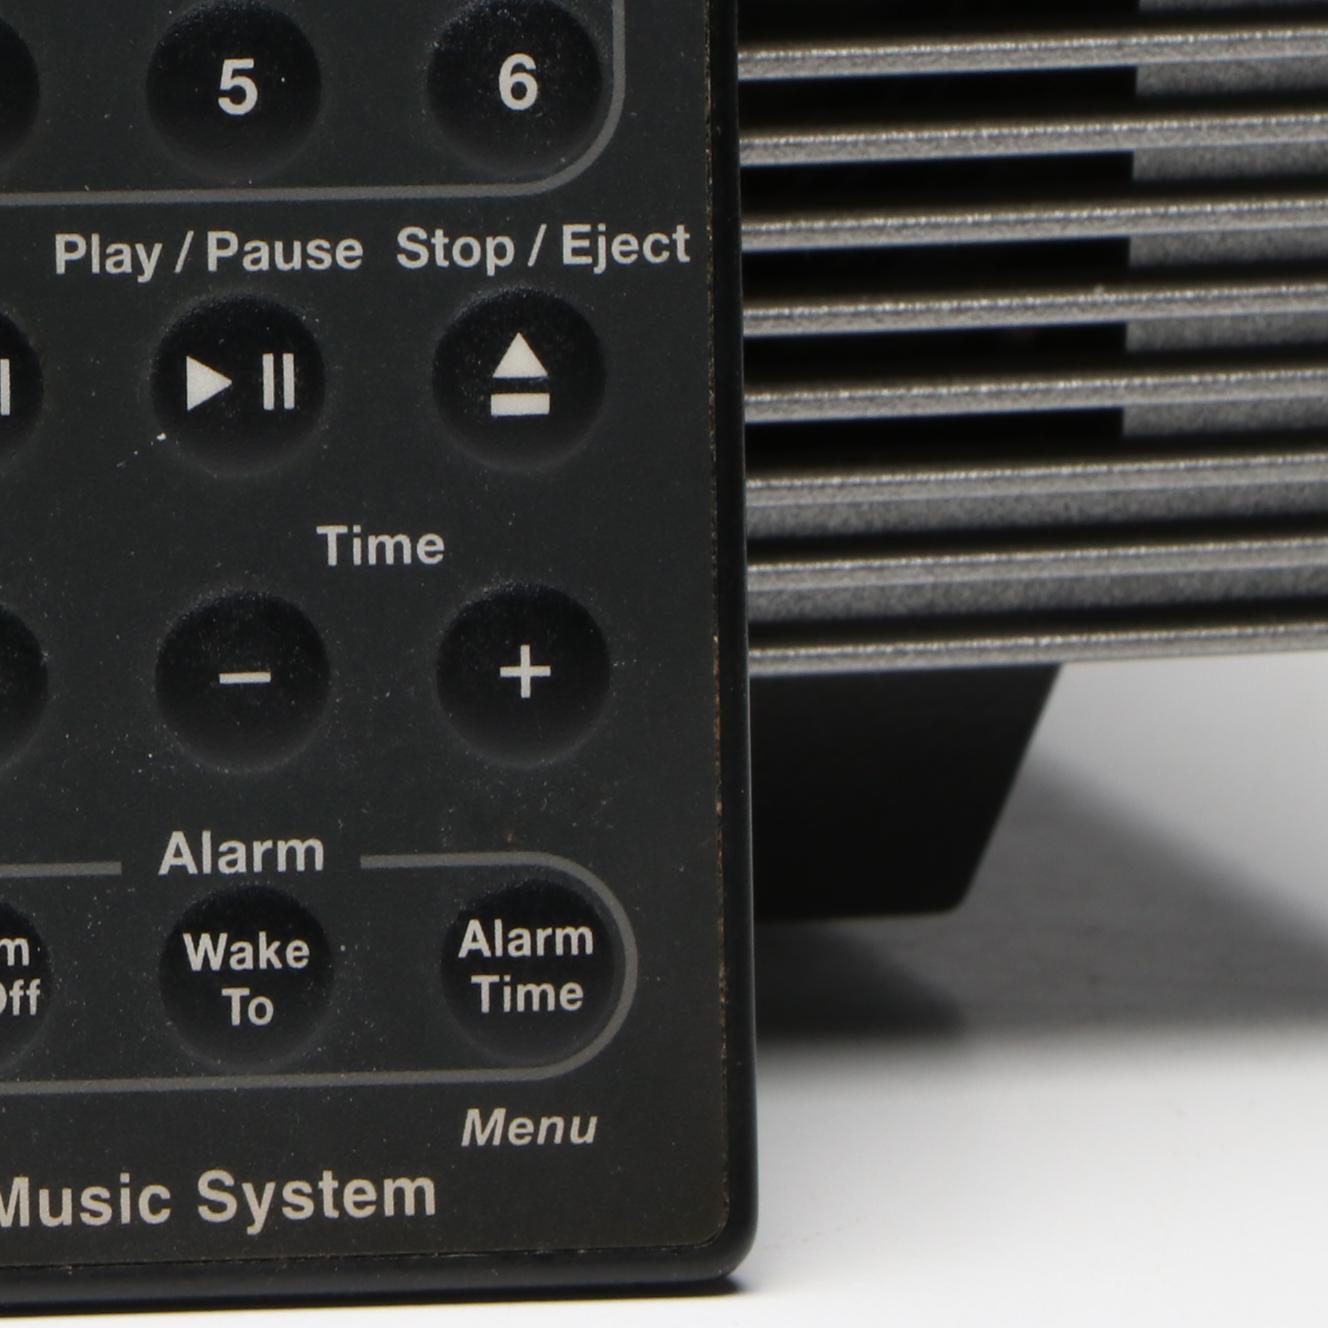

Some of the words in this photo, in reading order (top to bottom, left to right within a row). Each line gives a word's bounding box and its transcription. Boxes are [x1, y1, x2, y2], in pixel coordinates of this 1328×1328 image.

[218, 58, 258, 115] 5
[498, 53, 538, 111] 6
[55, 233, 163, 283] Play
[207, 230, 364, 272] Pause
[396, 226, 515, 277] Stop
[562, 223, 691, 274] Eject
[316, 524, 445, 566] Time
[158, 830, 324, 875] Alarm
[182, 931, 310, 971] Wake
[458, 918, 594, 958] Alarm
[221, 987, 274, 1026] To
[470, 974, 584, 1013] Time
[461, 1107, 598, 1147] Menu
[197, 1169, 436, 1235] System
